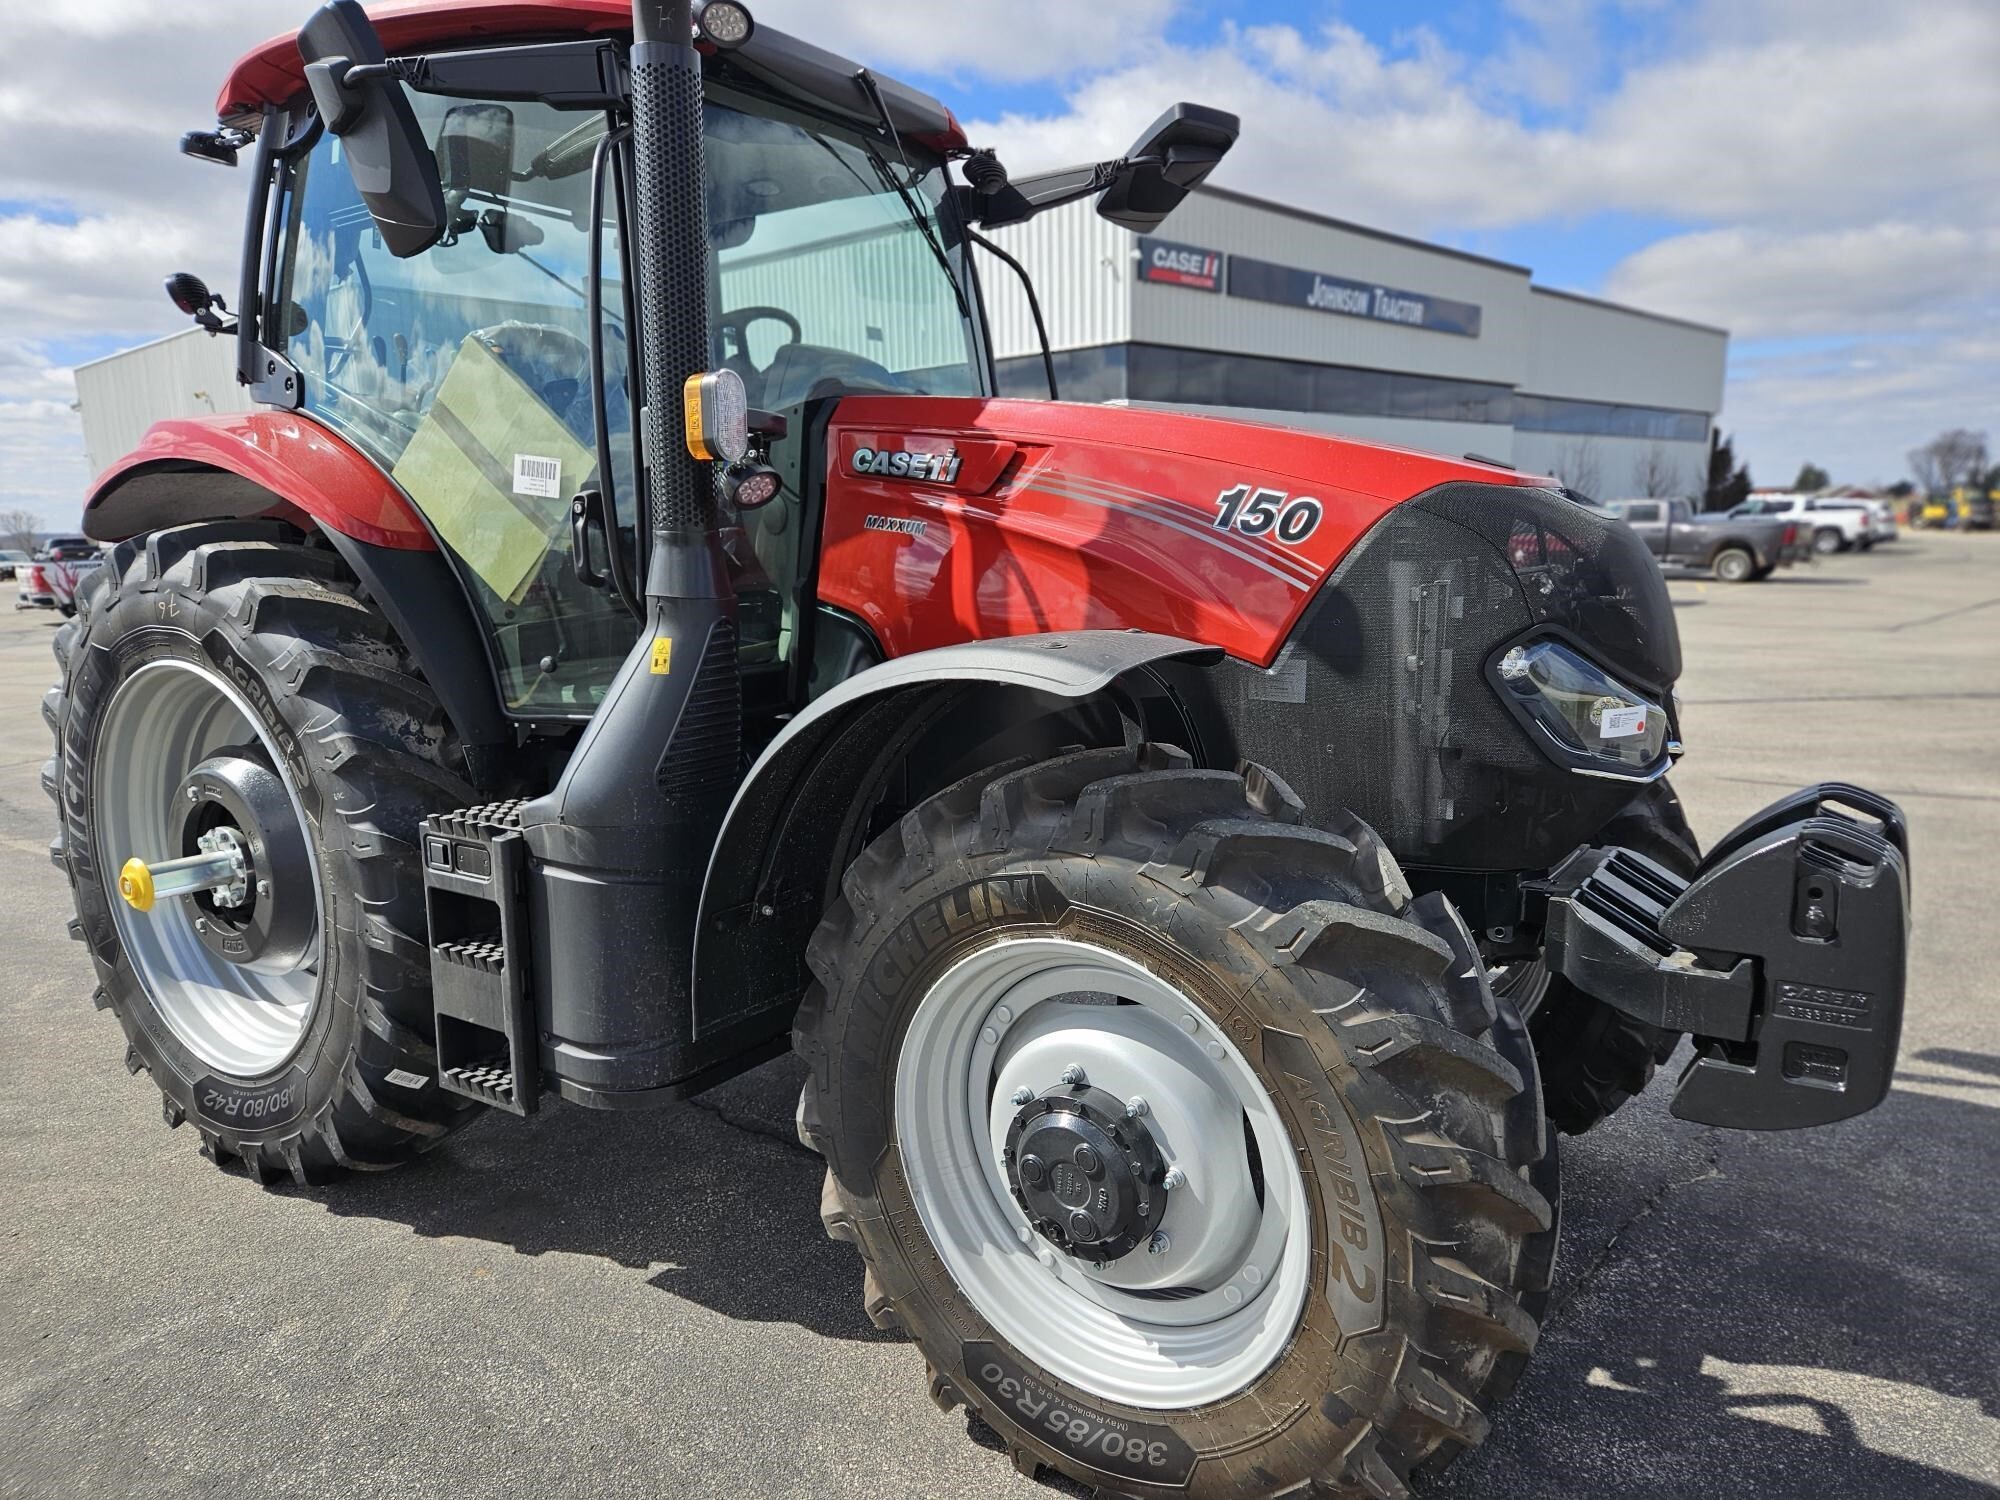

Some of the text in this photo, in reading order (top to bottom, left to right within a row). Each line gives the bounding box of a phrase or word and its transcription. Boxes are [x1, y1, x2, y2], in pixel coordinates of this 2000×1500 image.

[1152, 247, 1202, 274] CASE
[852, 447, 930, 478] CASE
[864, 514, 928, 535] MAXXUM
[1212, 483, 1324, 545] 150
[223, 655, 310, 790] AGRIBIB 2
[64, 660, 103, 883] MICHELIN
[843, 879, 1031, 1048] MICHELIN
[243, 1083, 297, 1118] 480/80
[1284, 1072, 1377, 1304] AGRIBIB 2
[980, 1362, 1168, 1467] 380/85 R30
[1066, 1402, 1105, 1425] Replace
[1105, 1416, 1129, 1432] (May
